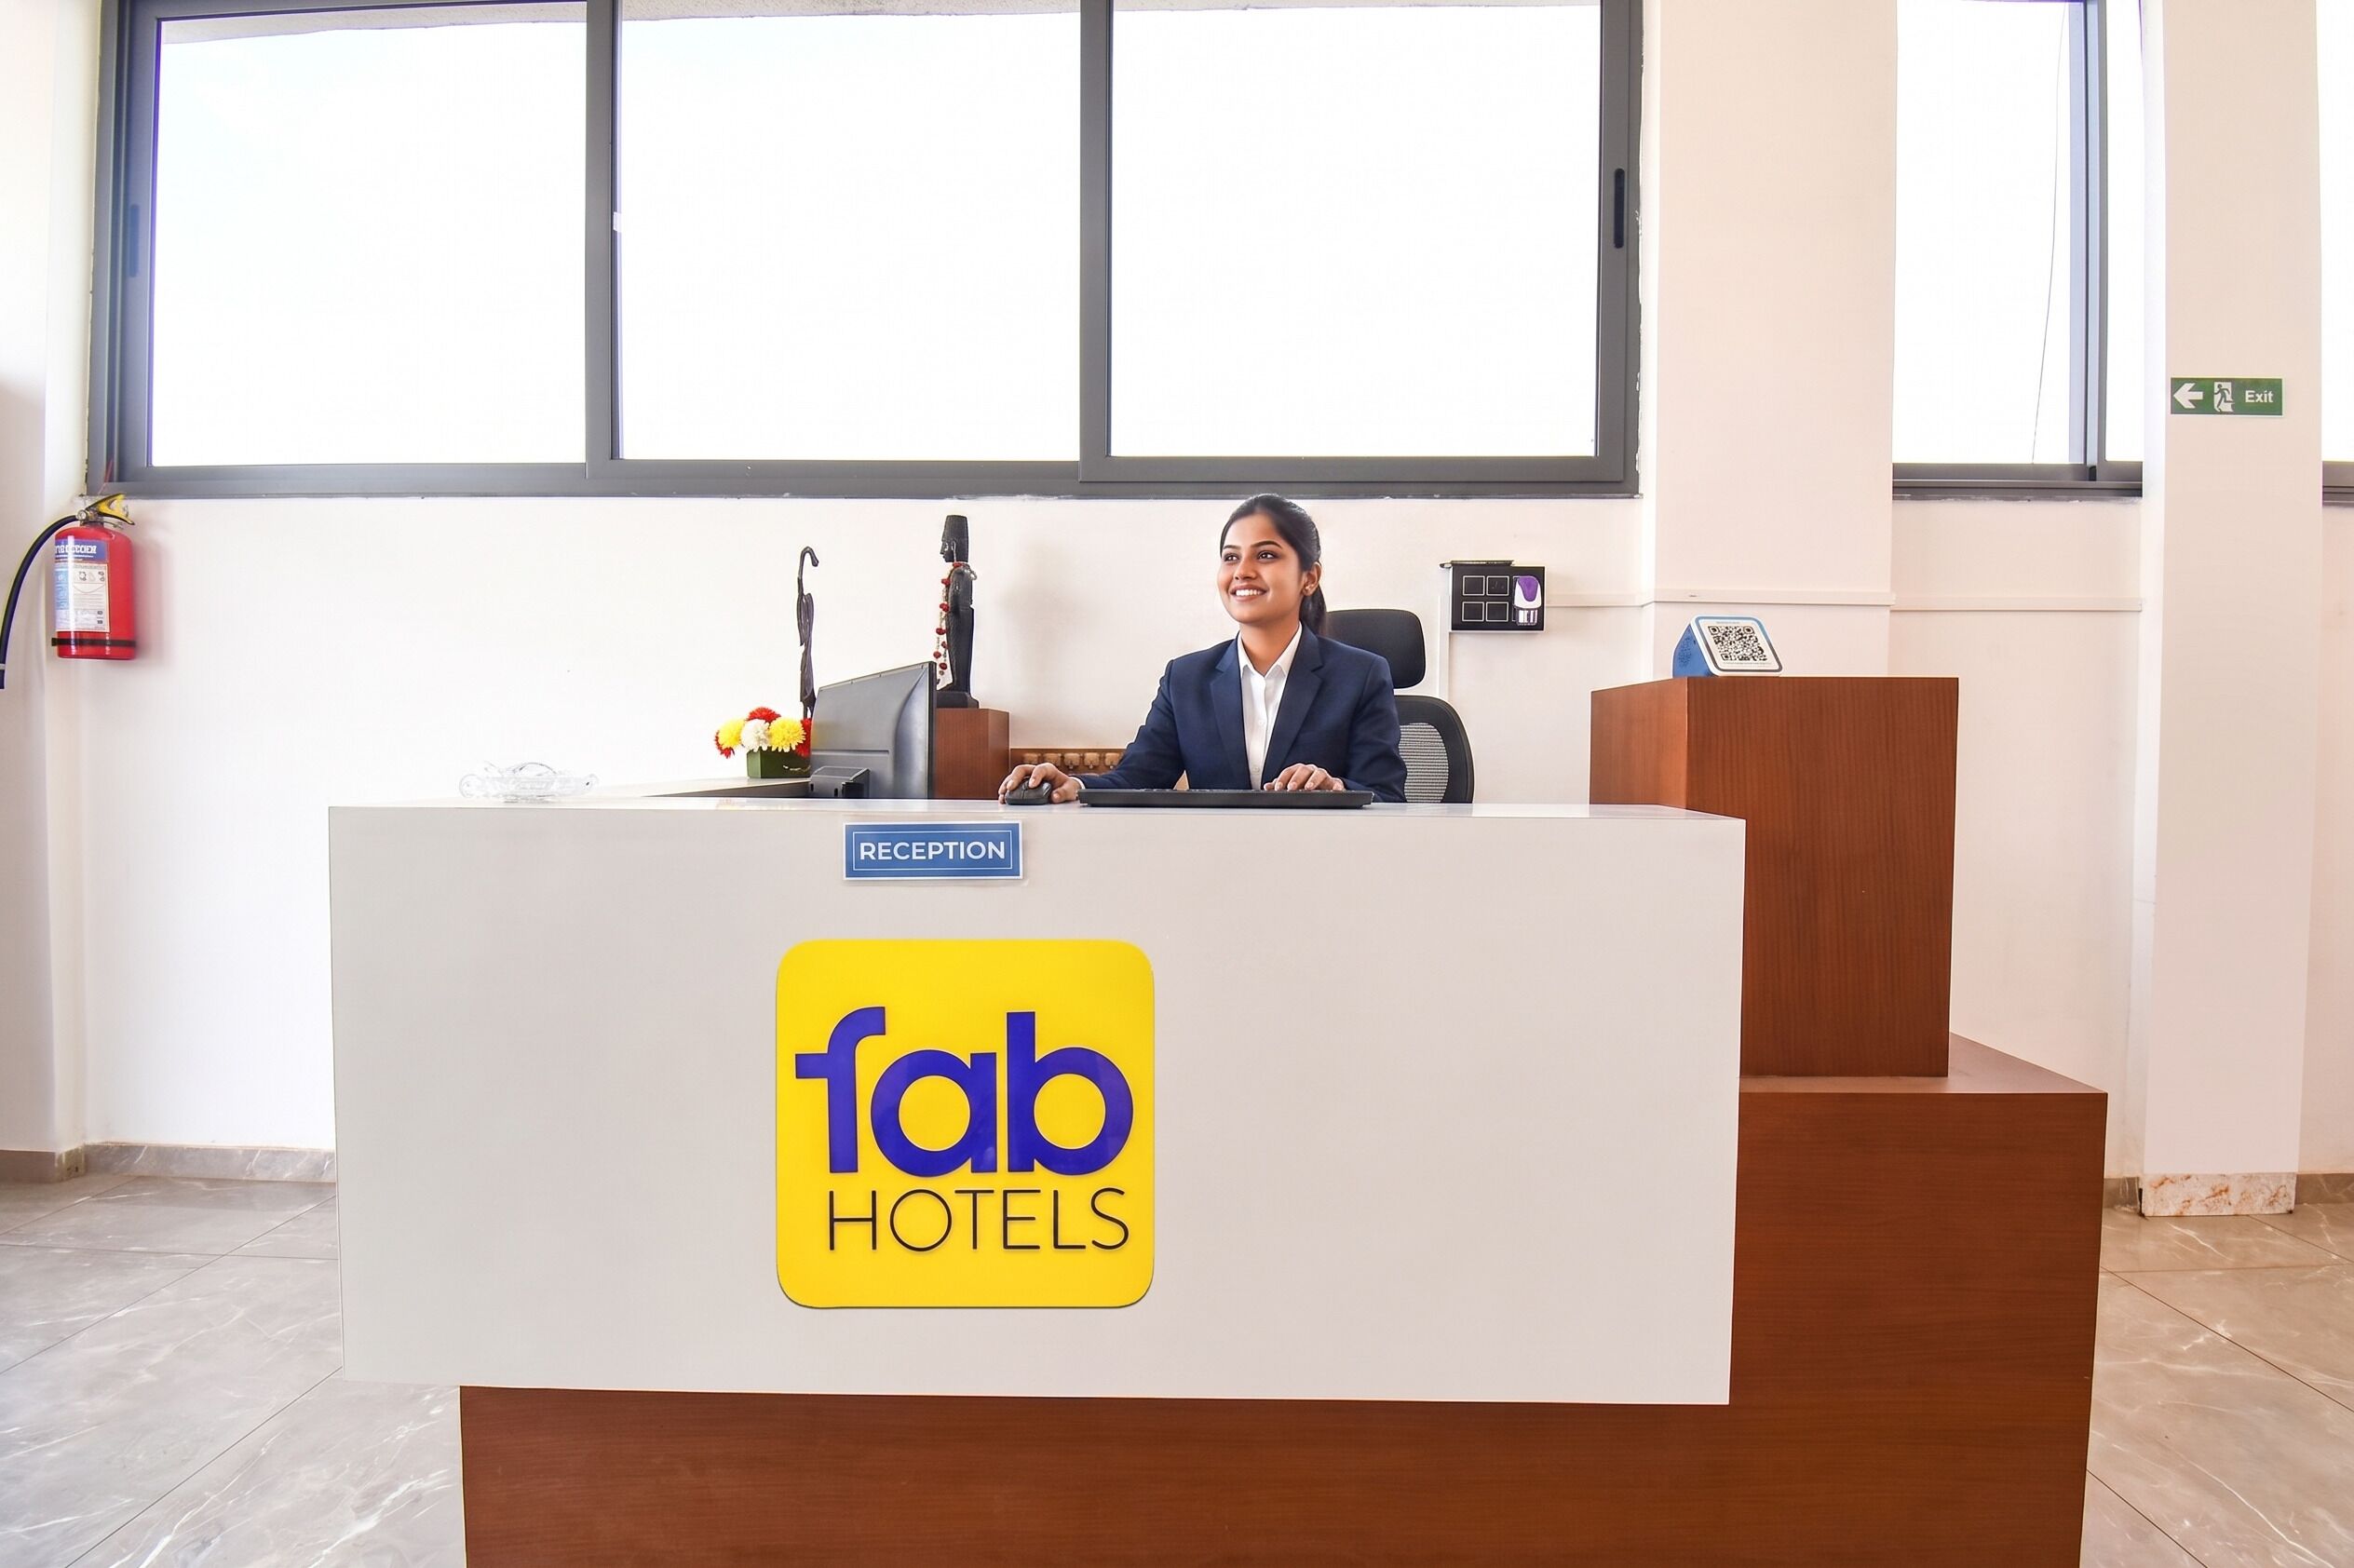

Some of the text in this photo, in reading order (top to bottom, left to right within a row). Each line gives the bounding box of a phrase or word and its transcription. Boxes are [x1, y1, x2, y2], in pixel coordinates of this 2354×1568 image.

[2244, 389, 2274, 403] Exit
[859, 841, 1006, 860] RECEPTION
[794, 1006, 1134, 1178] fab
[829, 1187, 1130, 1252] HOTELS
